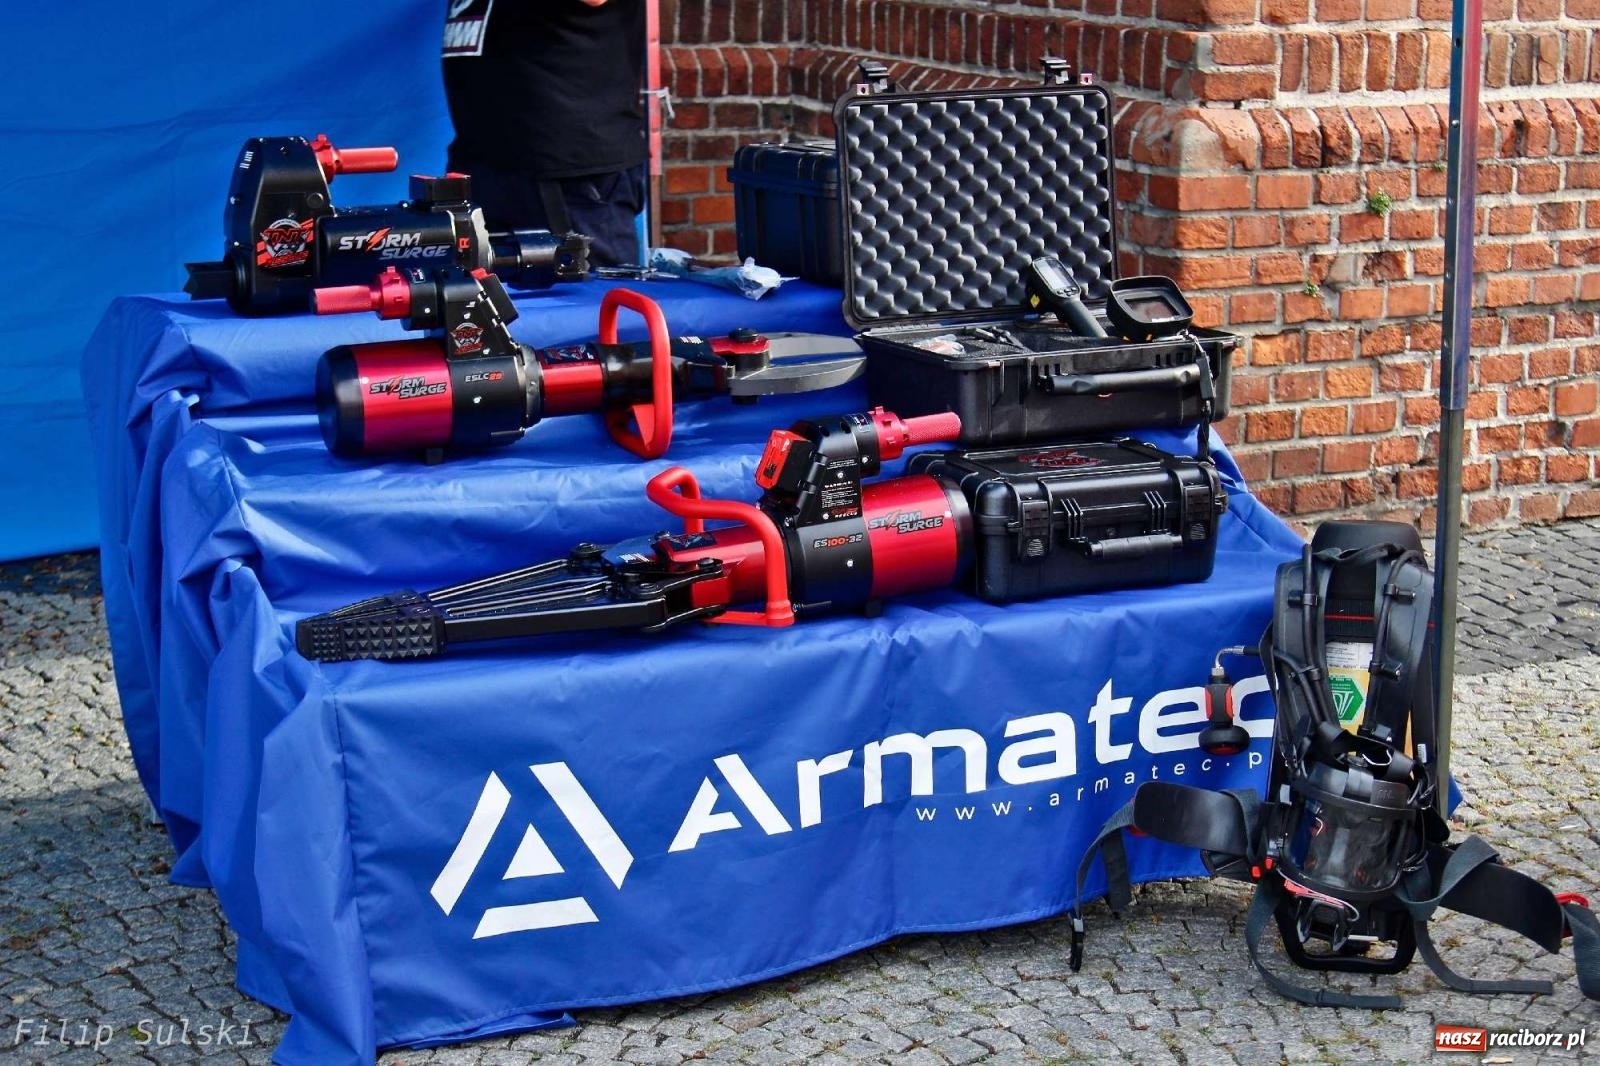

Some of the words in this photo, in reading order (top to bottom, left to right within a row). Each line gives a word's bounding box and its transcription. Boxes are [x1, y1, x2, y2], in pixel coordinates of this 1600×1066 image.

[339, 227, 421, 252] STORM
[380, 245, 451, 260] SURGE
[370, 375, 426, 393] STORM
[399, 383, 447, 399] SURGE
[868, 510, 922, 530] STORM
[898, 516, 944, 534] SURGE
[813, 534, 863, 549] ES100-32
[667, 674, 1277, 853] Armatec
[915, 751, 1263, 822] www.armatec.p
